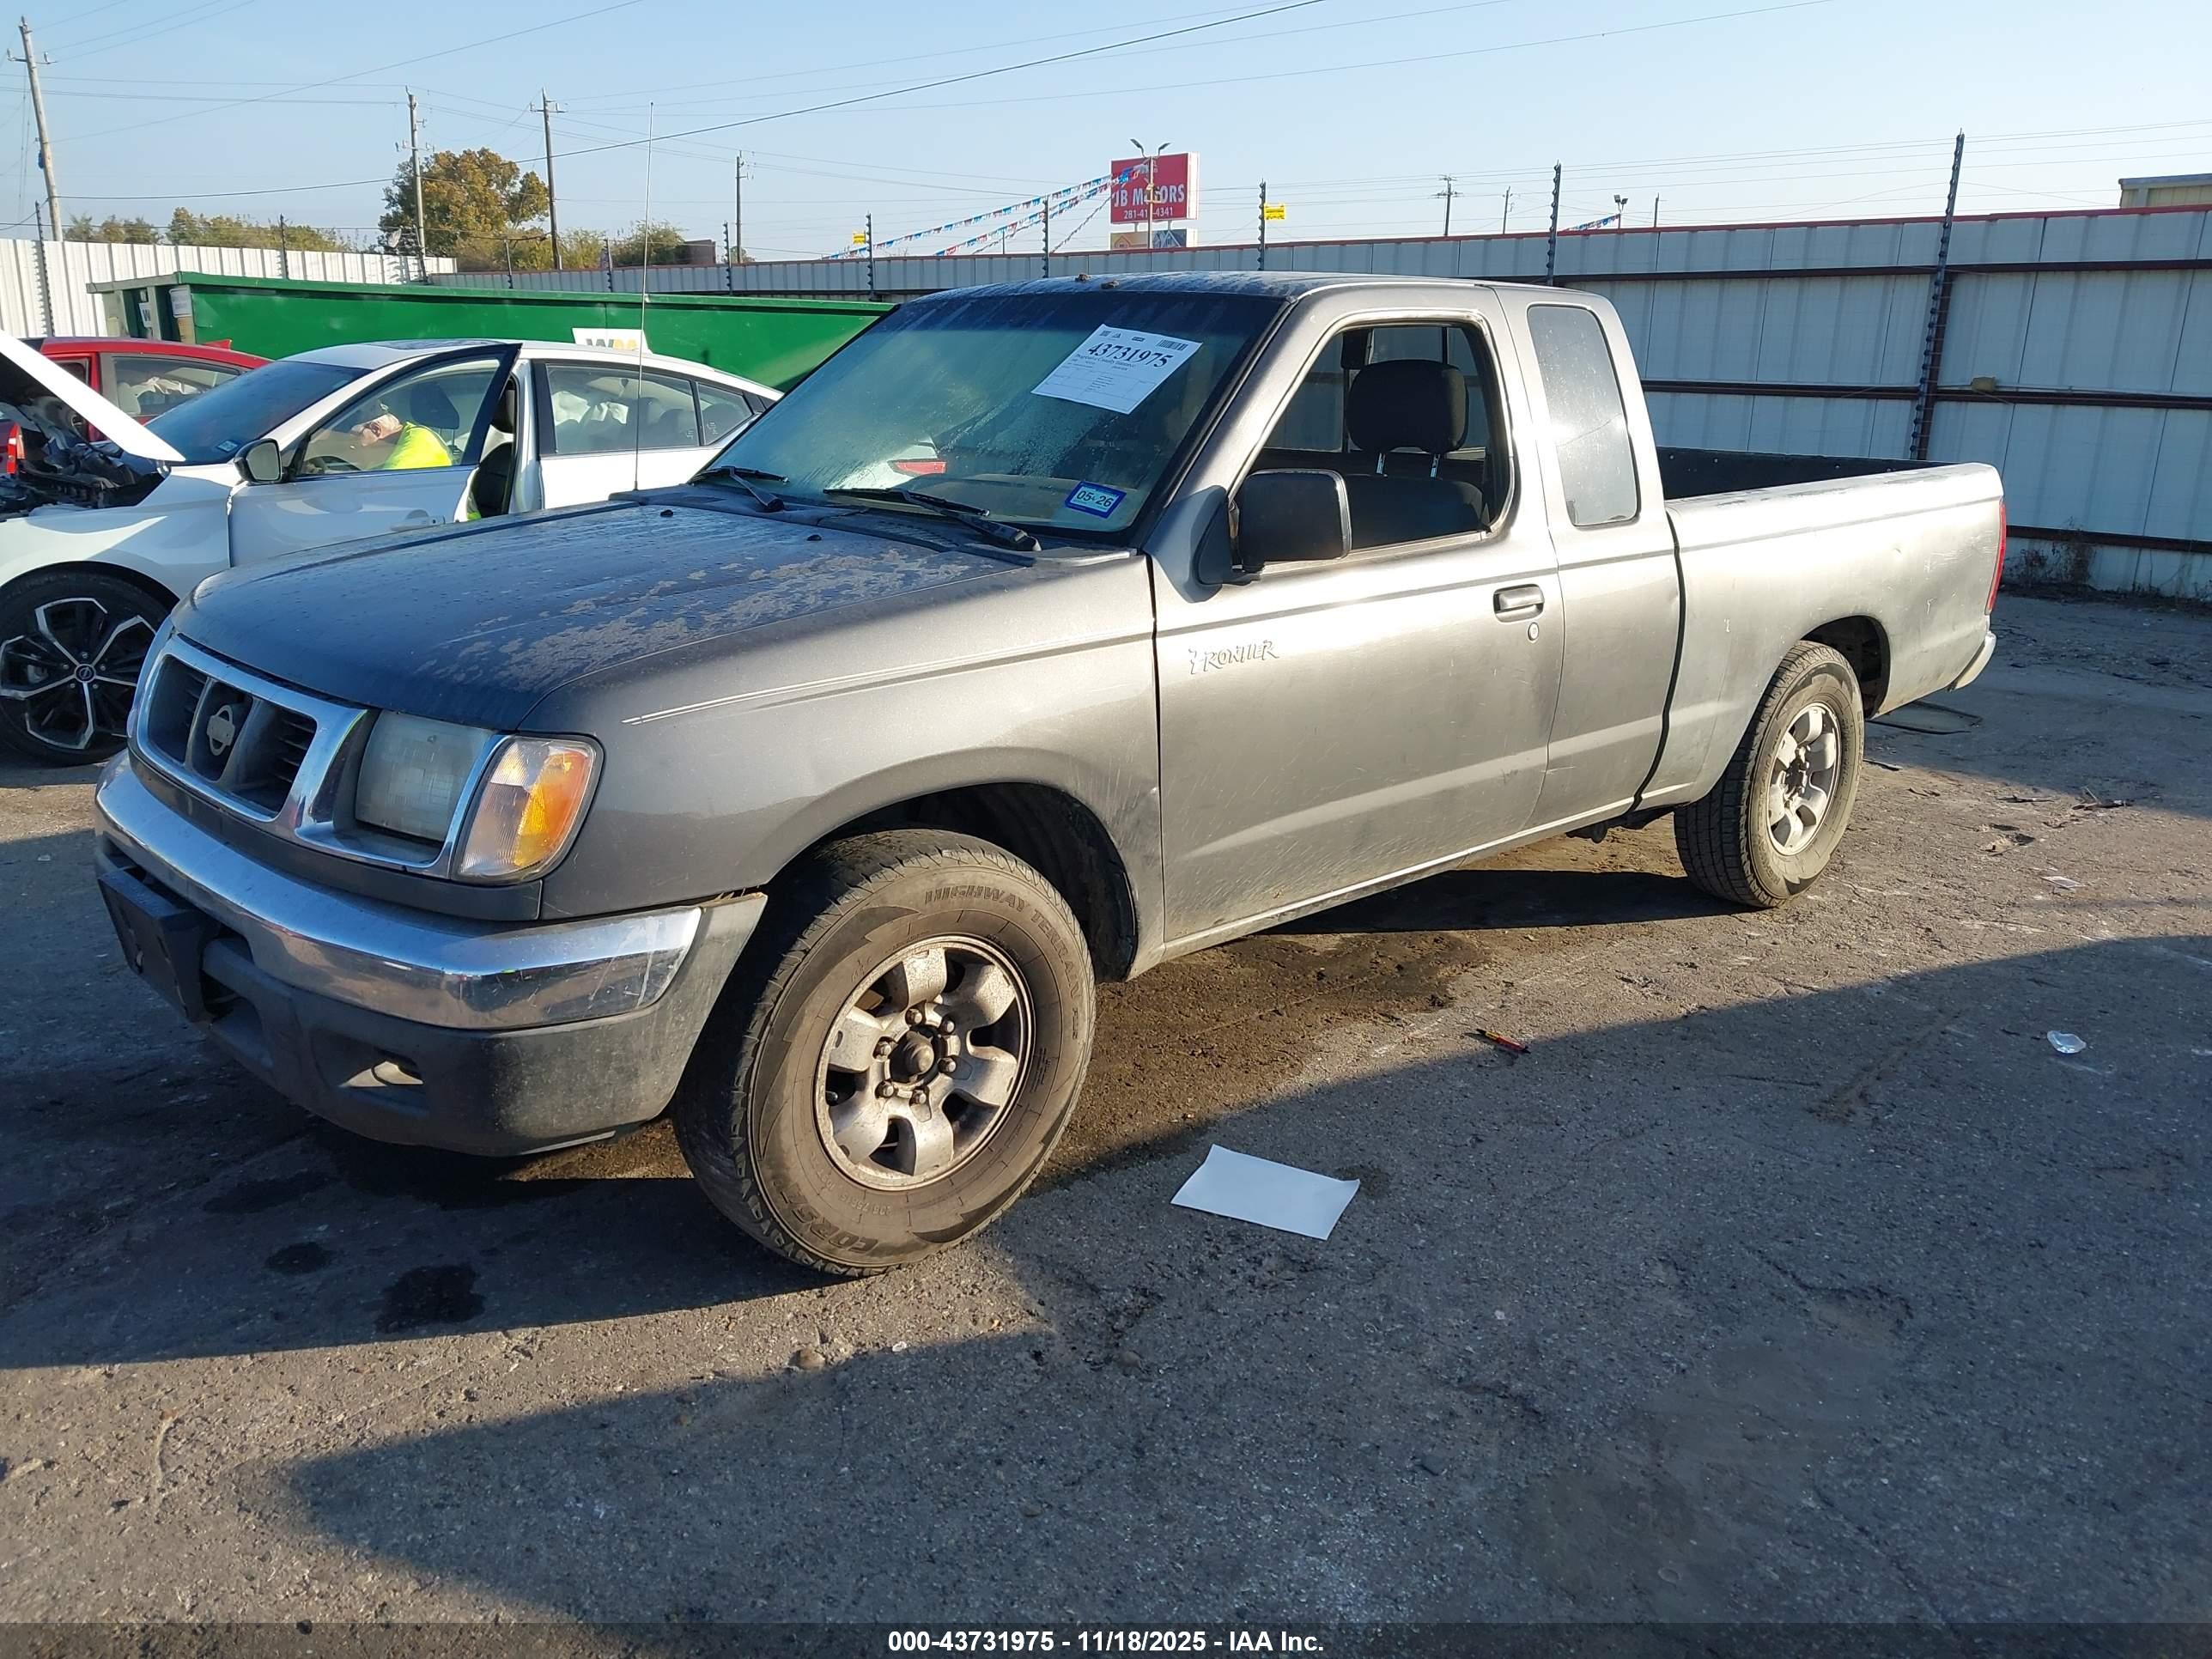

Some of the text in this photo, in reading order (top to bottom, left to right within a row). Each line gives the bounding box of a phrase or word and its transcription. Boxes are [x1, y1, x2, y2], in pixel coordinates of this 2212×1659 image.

[1114, 189, 1128, 207] JB
[1124, 206, 1173, 220] 281-41-4341
[1088, 343, 1174, 368] 43731975
[1076, 490, 1115, 507] 05 26
[925, 884, 1030, 913] HIGHWAY
